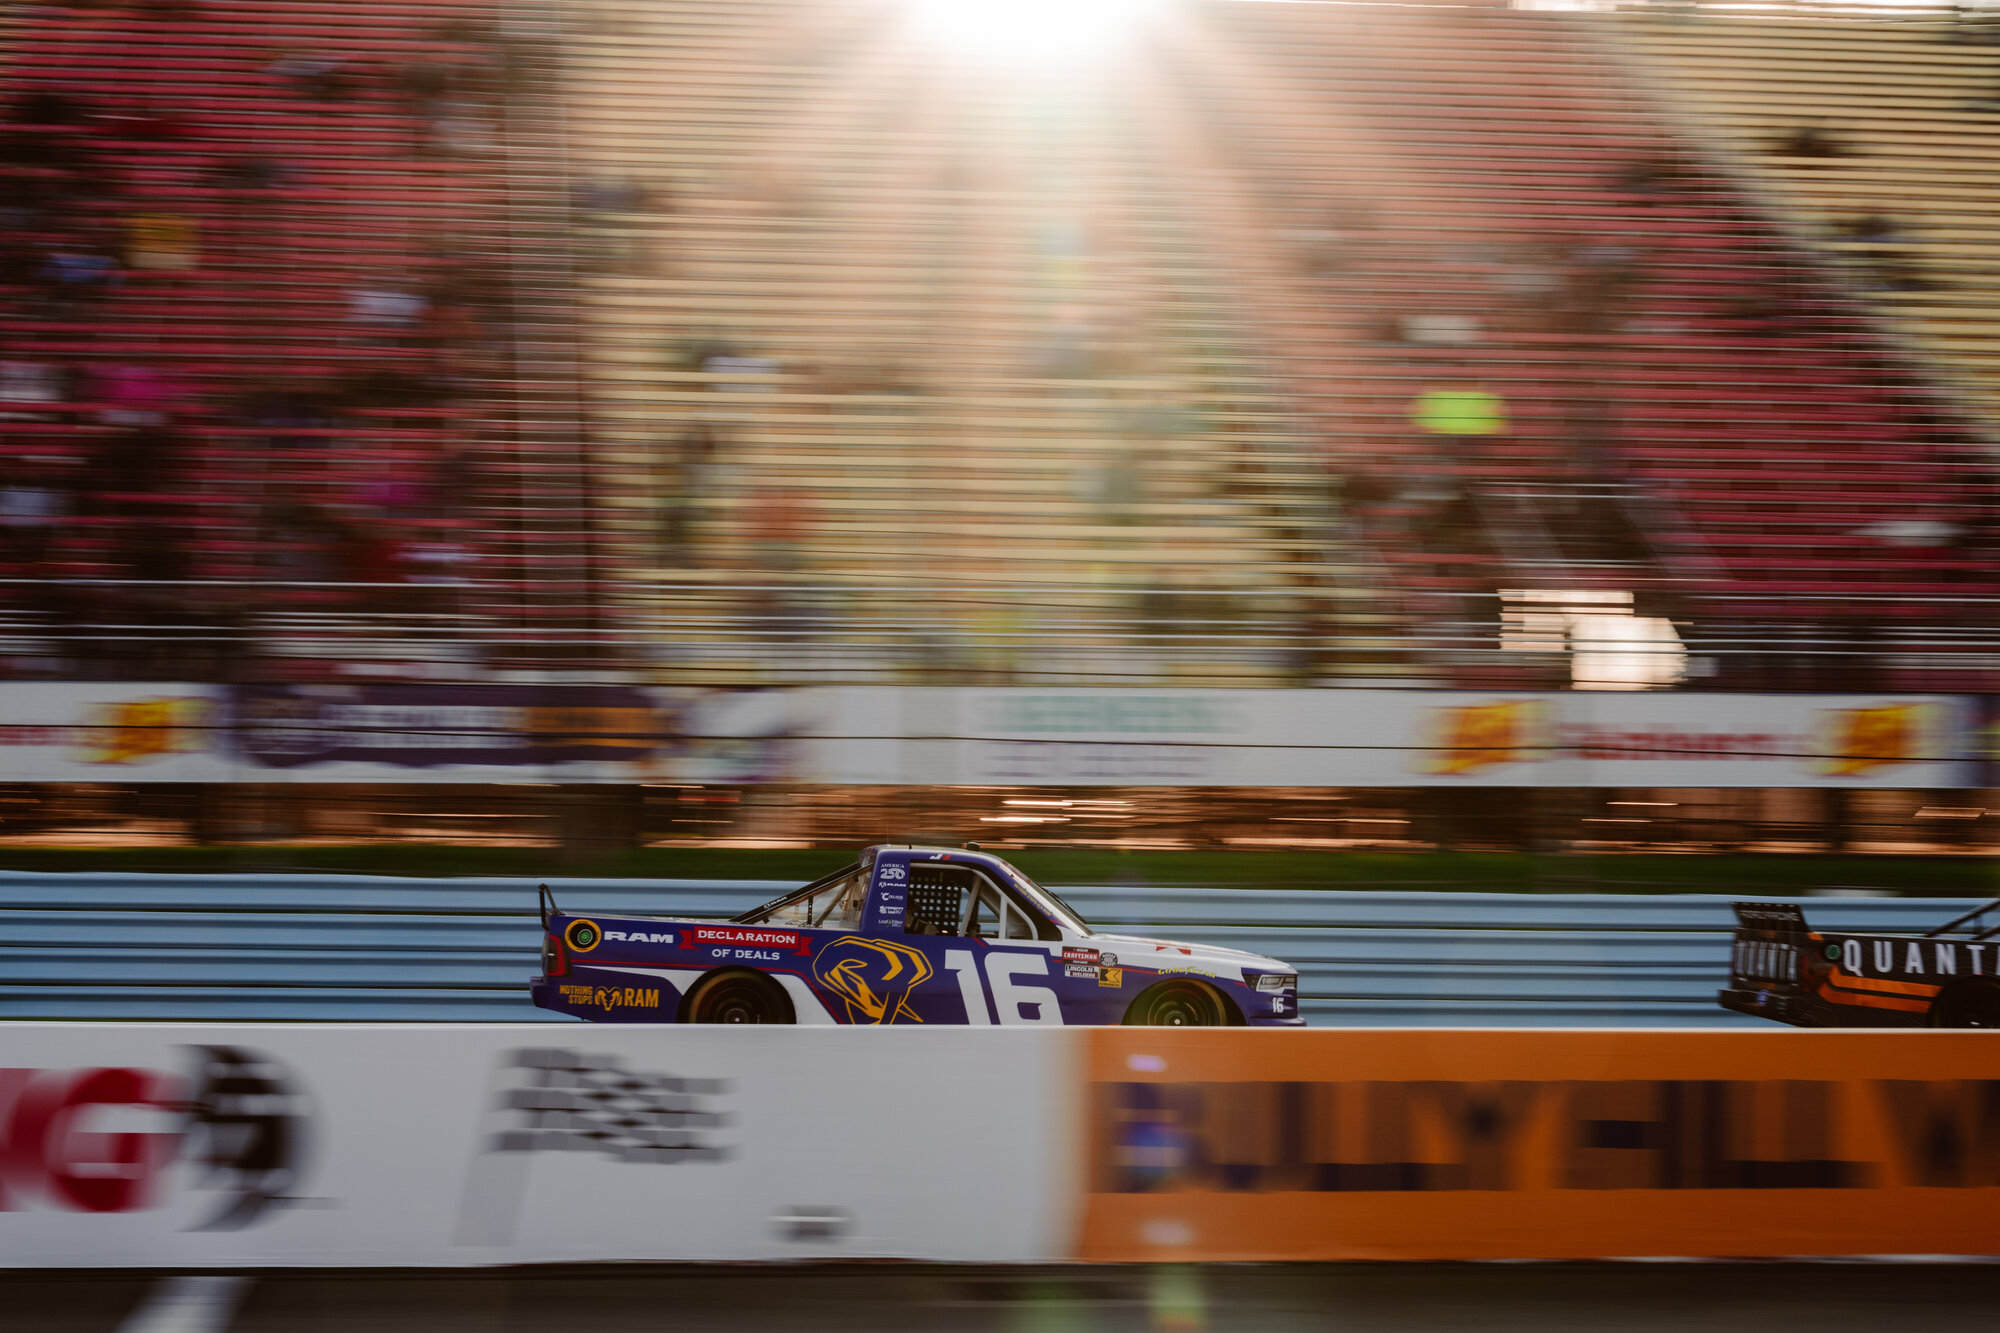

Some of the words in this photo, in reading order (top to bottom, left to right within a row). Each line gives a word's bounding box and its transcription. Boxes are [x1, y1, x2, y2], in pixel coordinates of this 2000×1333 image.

[880, 868, 906, 880] 250
[603, 930, 674, 944] RAM
[697, 929, 796, 944] DECLARATION
[712, 948, 732, 958] OF
[735, 949, 781, 961] DEALS
[1063, 952, 1099, 960] CRAFTSMAN
[1066, 965, 1095, 973] LINCOLN
[559, 985, 593, 995] NOTHING
[944, 949, 1065, 1025] 16
[568, 995, 593, 1004] STOPS
[624, 988, 660, 1008] RAM
[1272, 997, 1284, 1014] 16
